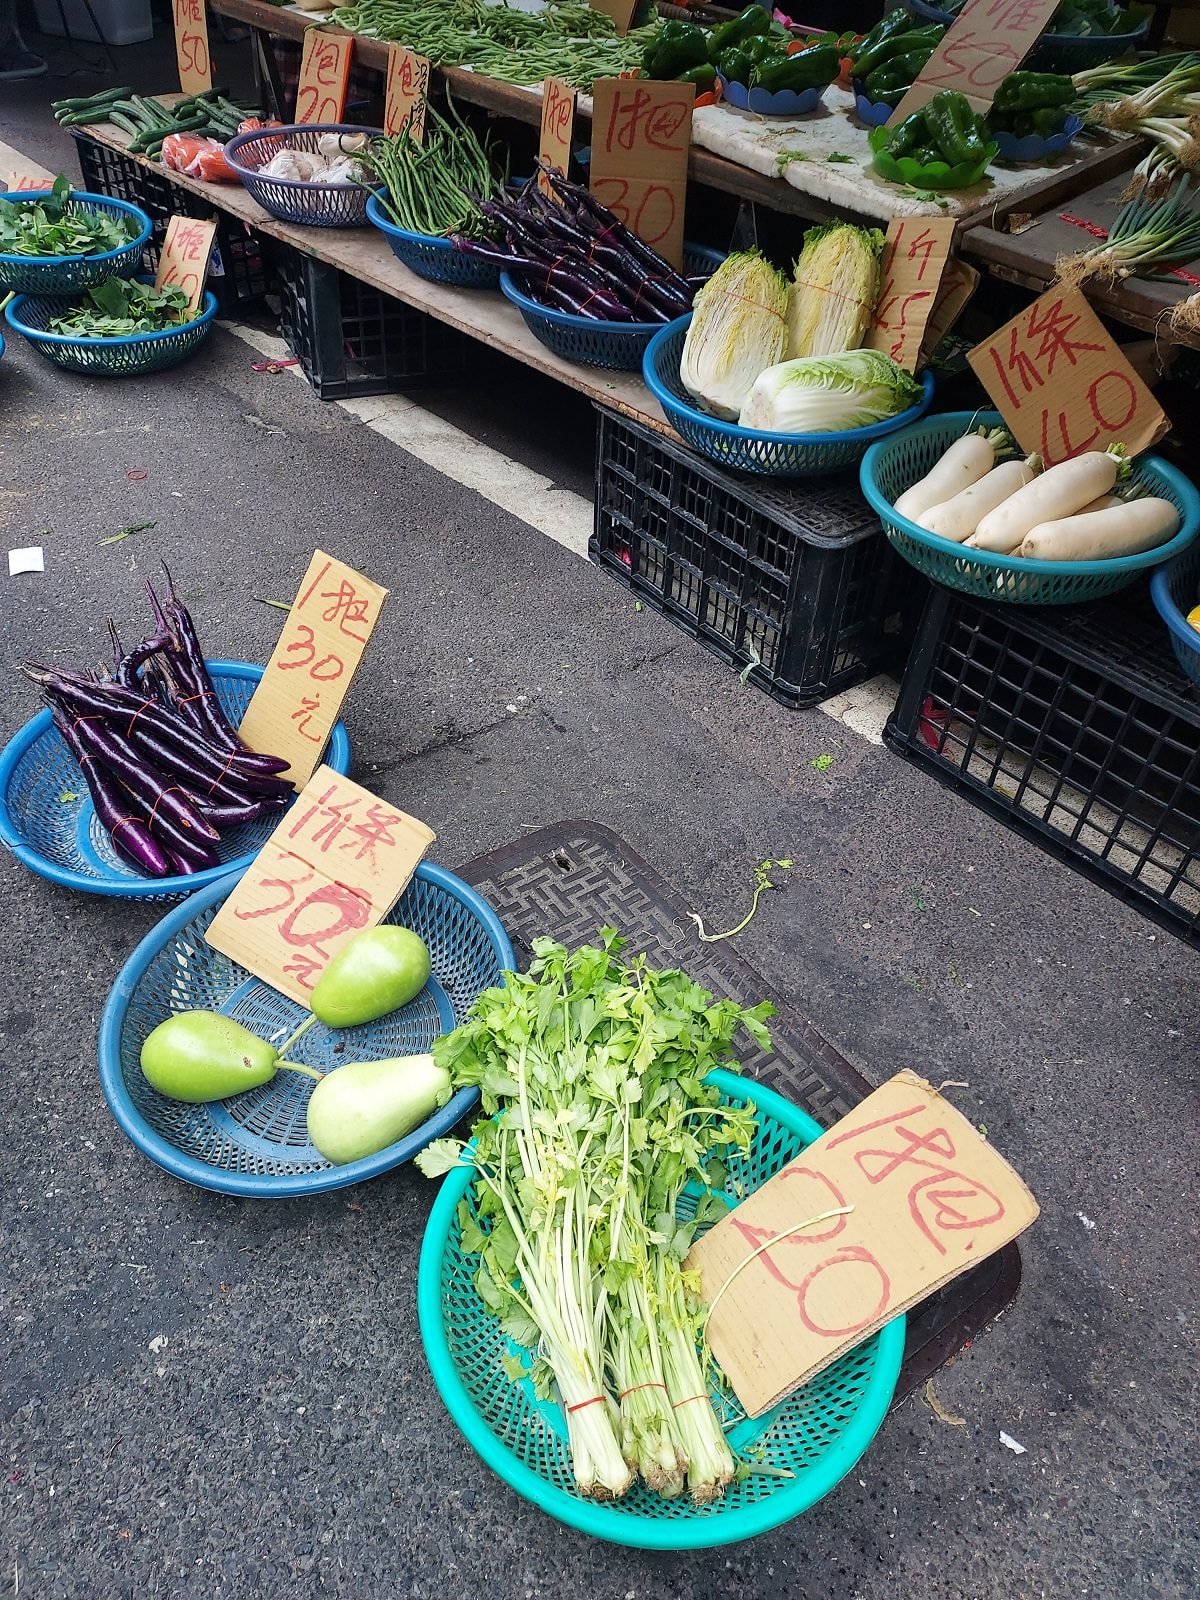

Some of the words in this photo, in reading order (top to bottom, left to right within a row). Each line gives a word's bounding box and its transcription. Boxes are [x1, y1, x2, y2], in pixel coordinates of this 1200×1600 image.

[180, 30, 208, 76] 50
[304, 38, 340, 86] 1包
[387, 49, 414, 97] 1包
[915, 31, 1020, 87] 50
[299, 86, 338, 124] 20
[543, 81, 571, 145] 1把
[606, 88, 688, 153] 1把
[593, 178, 675, 244] 30
[885, 222, 938, 281] 1斤
[989, 299, 1106, 409] 1條
[1040, 370, 1137, 467] 40
[297, 561, 369, 643] 1把
[277, 625, 344, 682] 30
[291, 692, 321, 743] 元
[288, 784, 402, 876] 1條
[234, 850, 373, 947] 30
[825, 1104, 1006, 1256] 1把
[730, 1166, 890, 1338] 20
